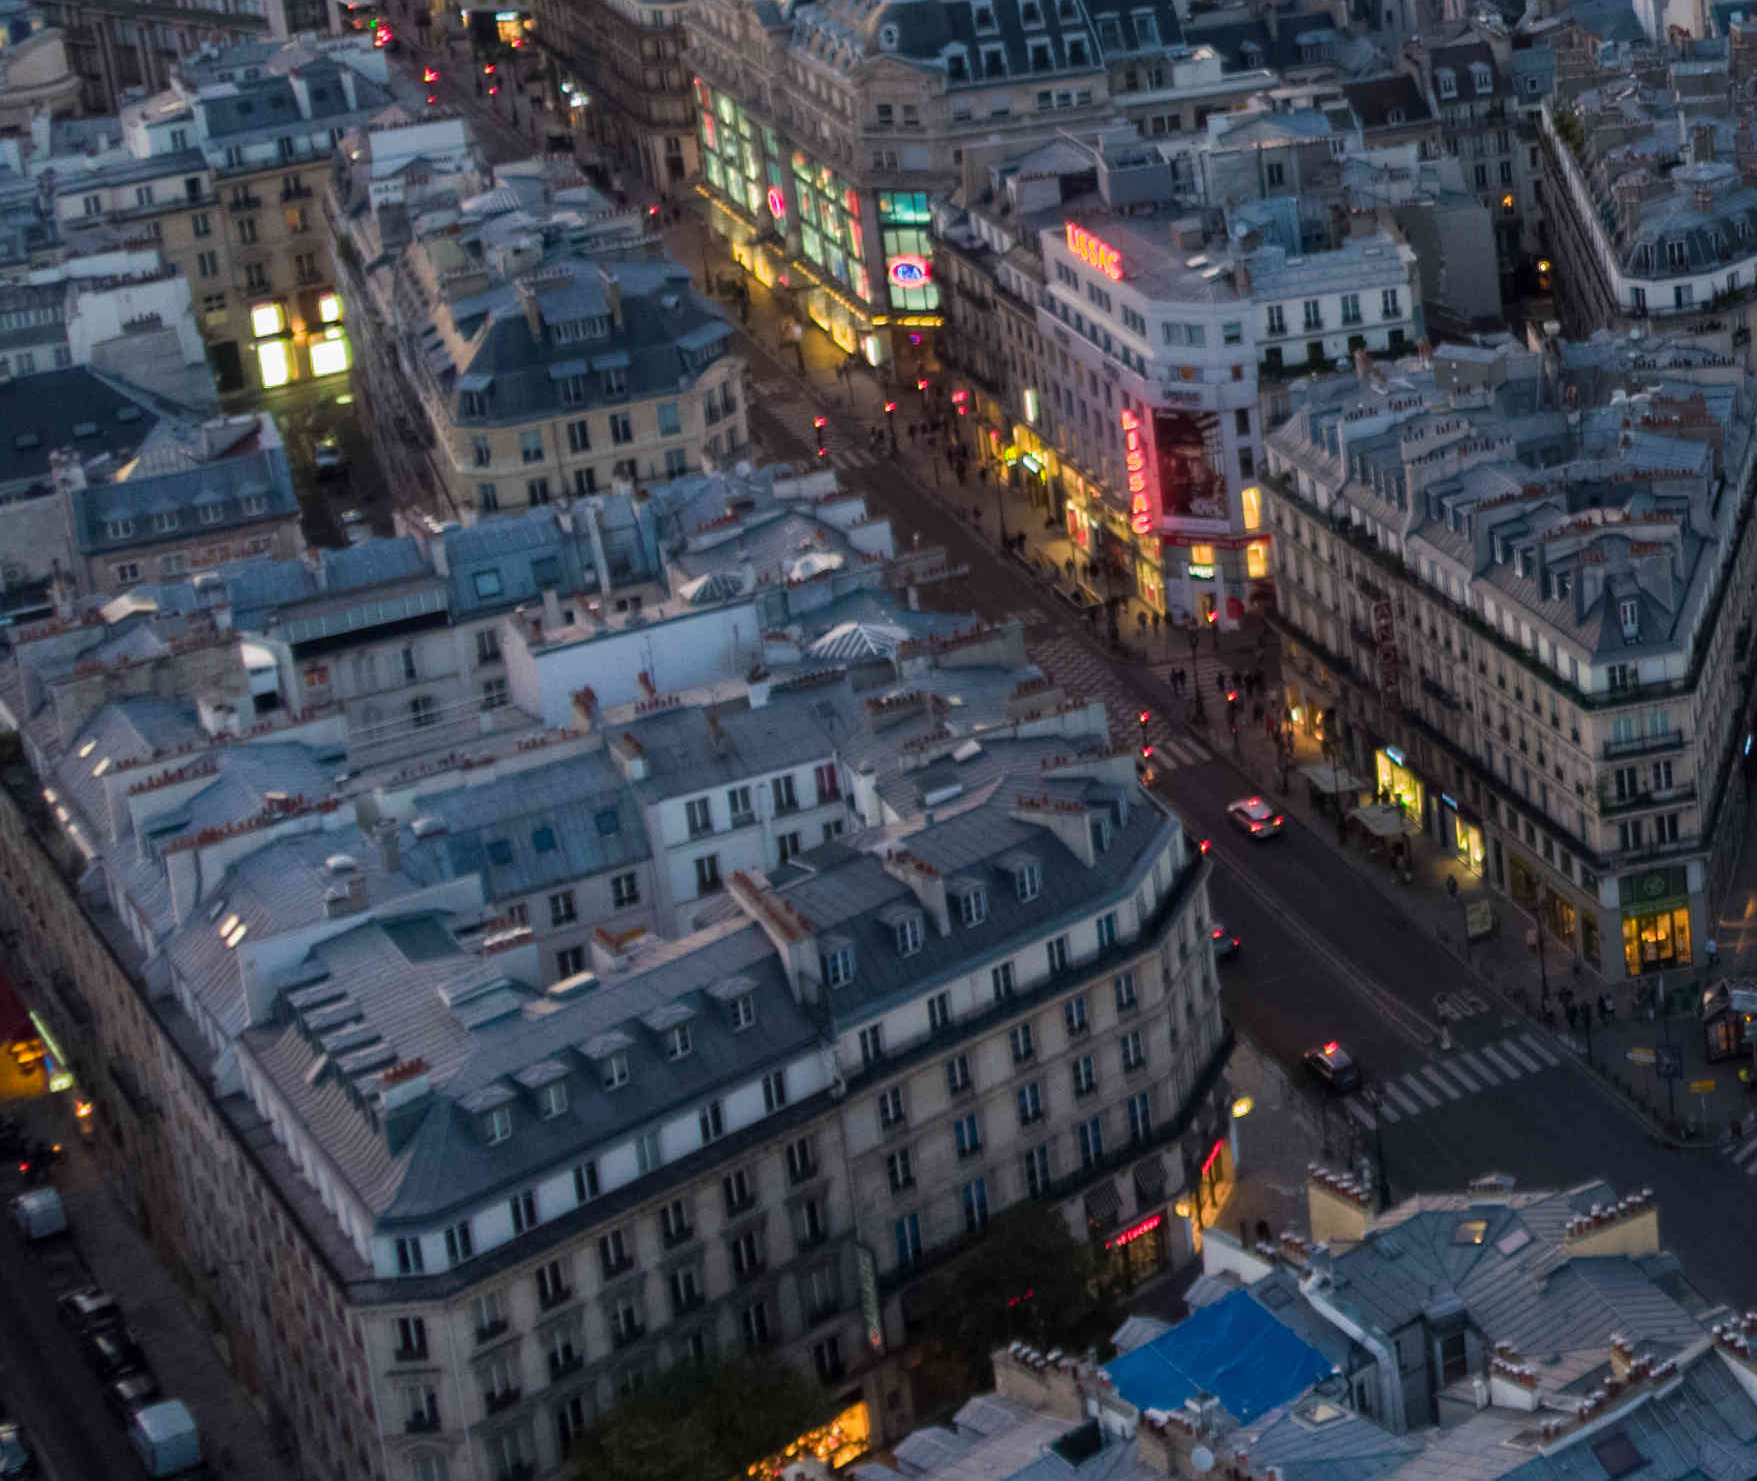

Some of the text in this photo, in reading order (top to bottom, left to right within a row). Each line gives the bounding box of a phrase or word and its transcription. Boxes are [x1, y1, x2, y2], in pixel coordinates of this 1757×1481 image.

[897, 264, 921, 280] C&A
[1066, 221, 1122, 281] LISSAC
[1122, 409, 1152, 535] LISSAC
